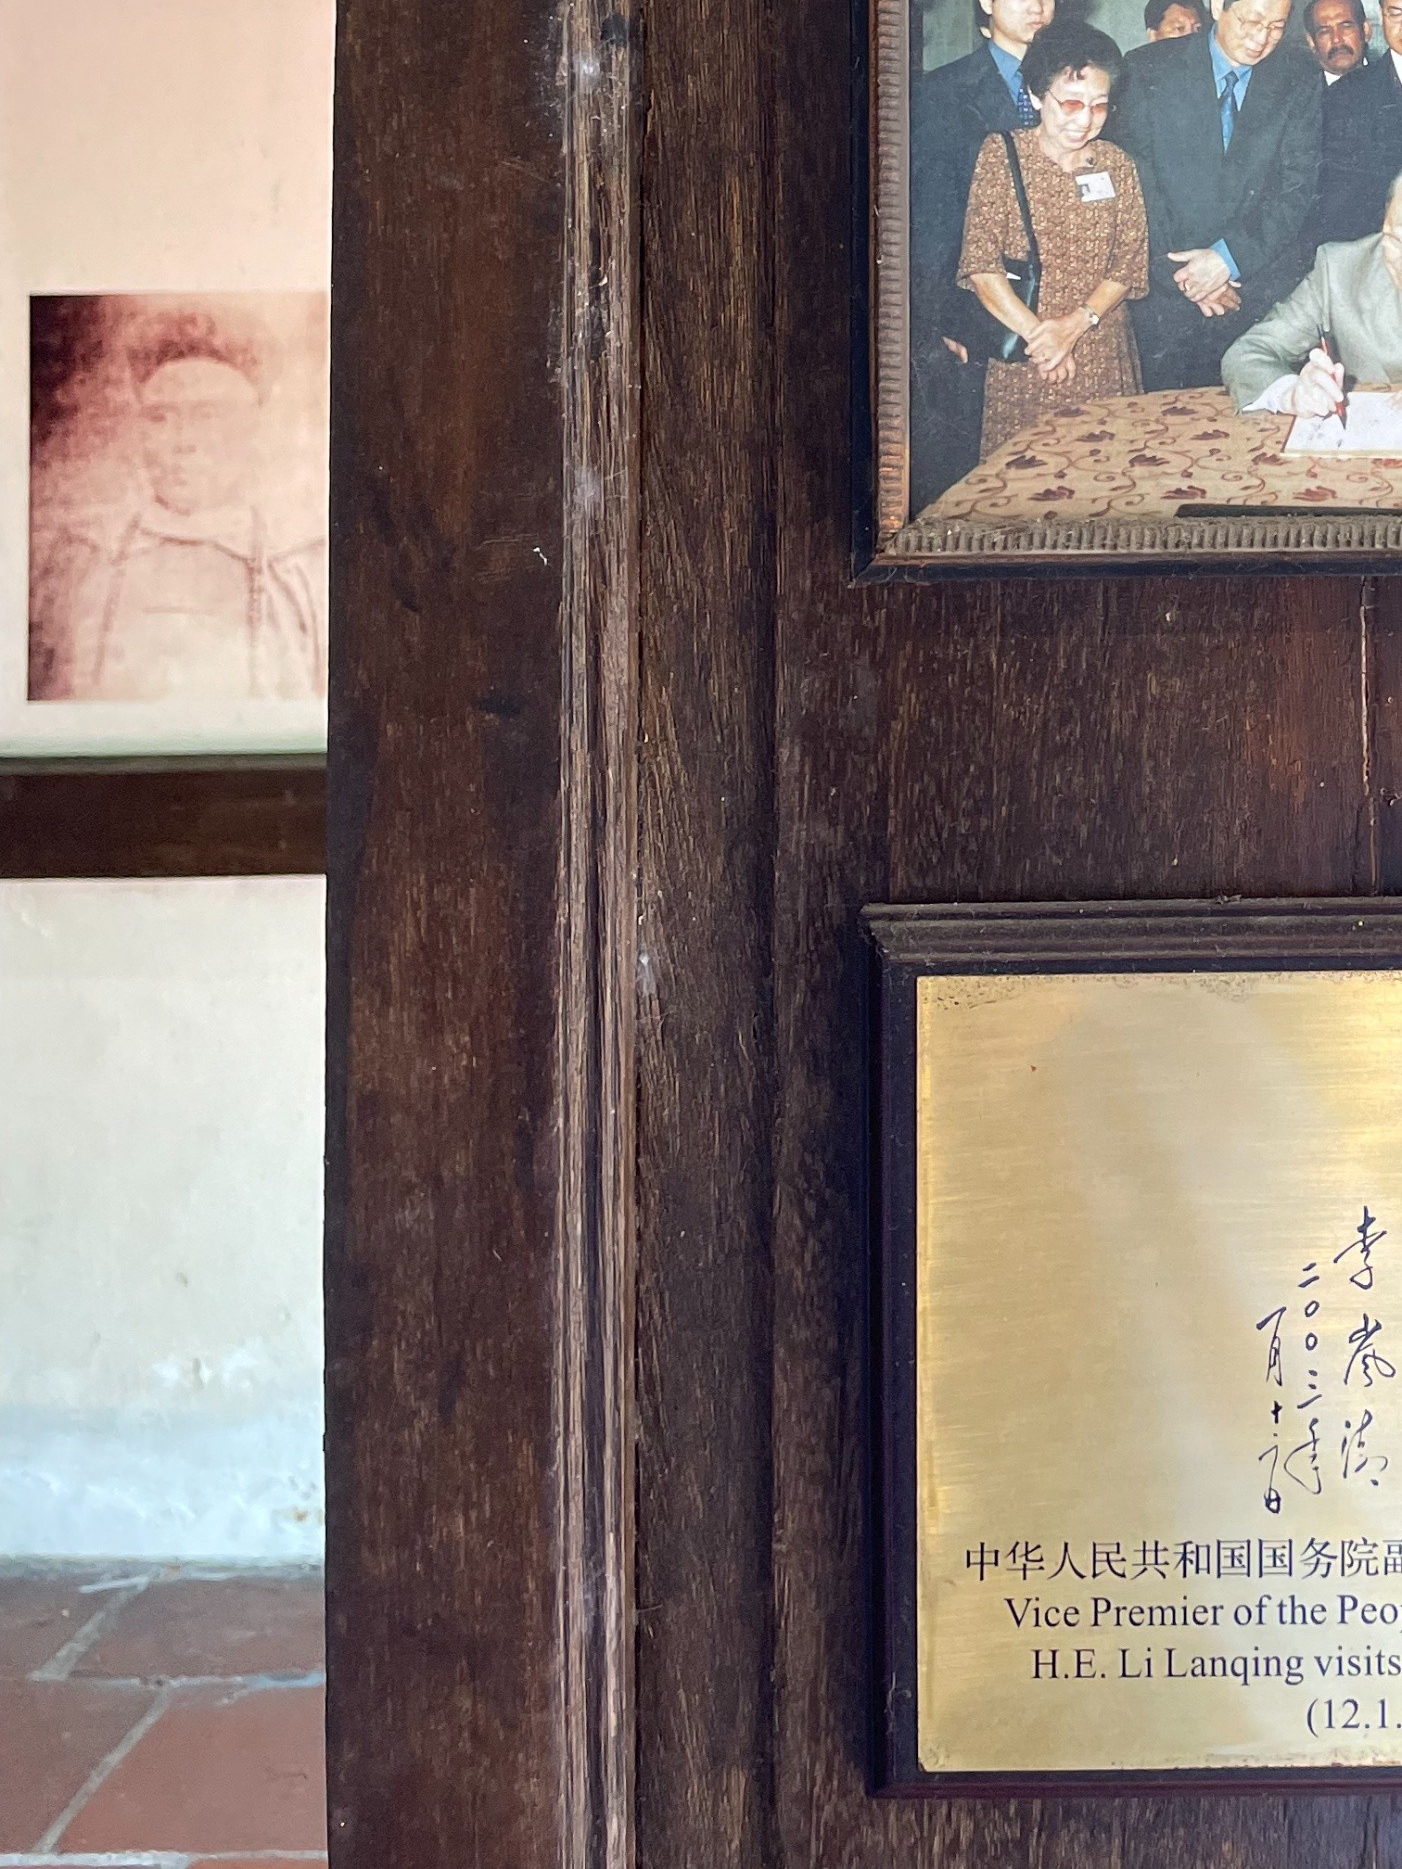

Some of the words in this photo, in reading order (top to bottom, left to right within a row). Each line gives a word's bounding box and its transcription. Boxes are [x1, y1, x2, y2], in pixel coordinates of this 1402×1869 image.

[1003, 1596, 1080, 1628] Vice
[1090, 1595, 1224, 1627] Premier
[1233, 1594, 1272, 1626] of
[1276, 1594, 1327, 1625] the
[1031, 1648, 1107, 1679] H.E.
[1117, 1647, 1154, 1678] Li
[1164, 1646, 1304, 1686] Lanqing
[1313, 1644, 1402, 1676] visits
